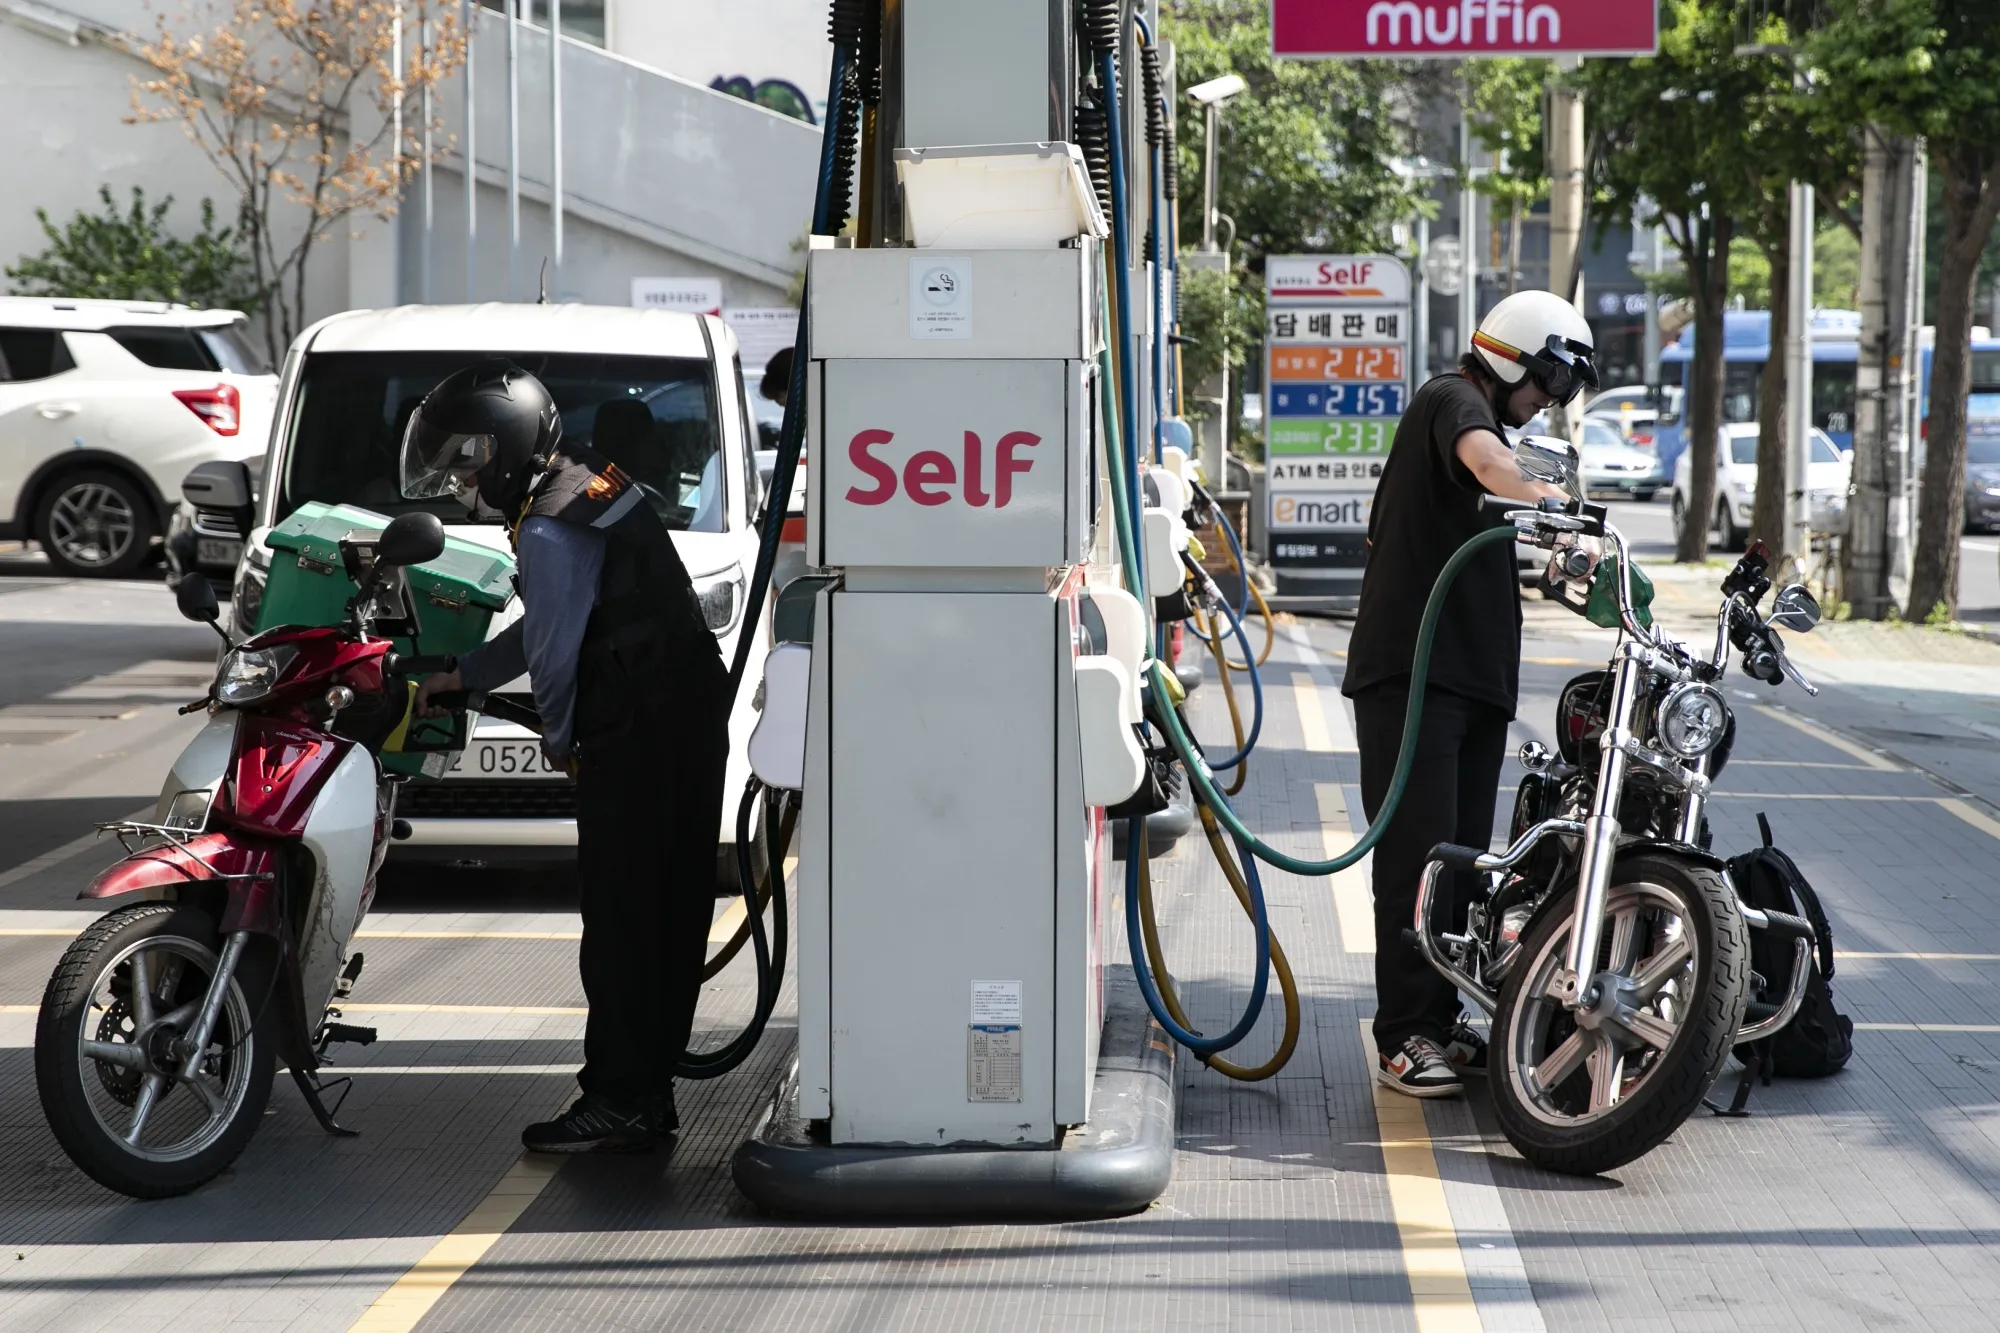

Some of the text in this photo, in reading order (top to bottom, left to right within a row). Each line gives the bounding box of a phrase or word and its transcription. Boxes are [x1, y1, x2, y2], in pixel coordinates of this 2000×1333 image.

[1366, 0, 1561, 46] muffin
[1317, 262, 1374, 285] Self
[1324, 348, 1401, 378] 2127
[1325, 385, 1404, 415] 2157
[1324, 422, 1398, 452] 233
[845, 429, 1042, 508] Self
[1274, 497, 1371, 524] emart
